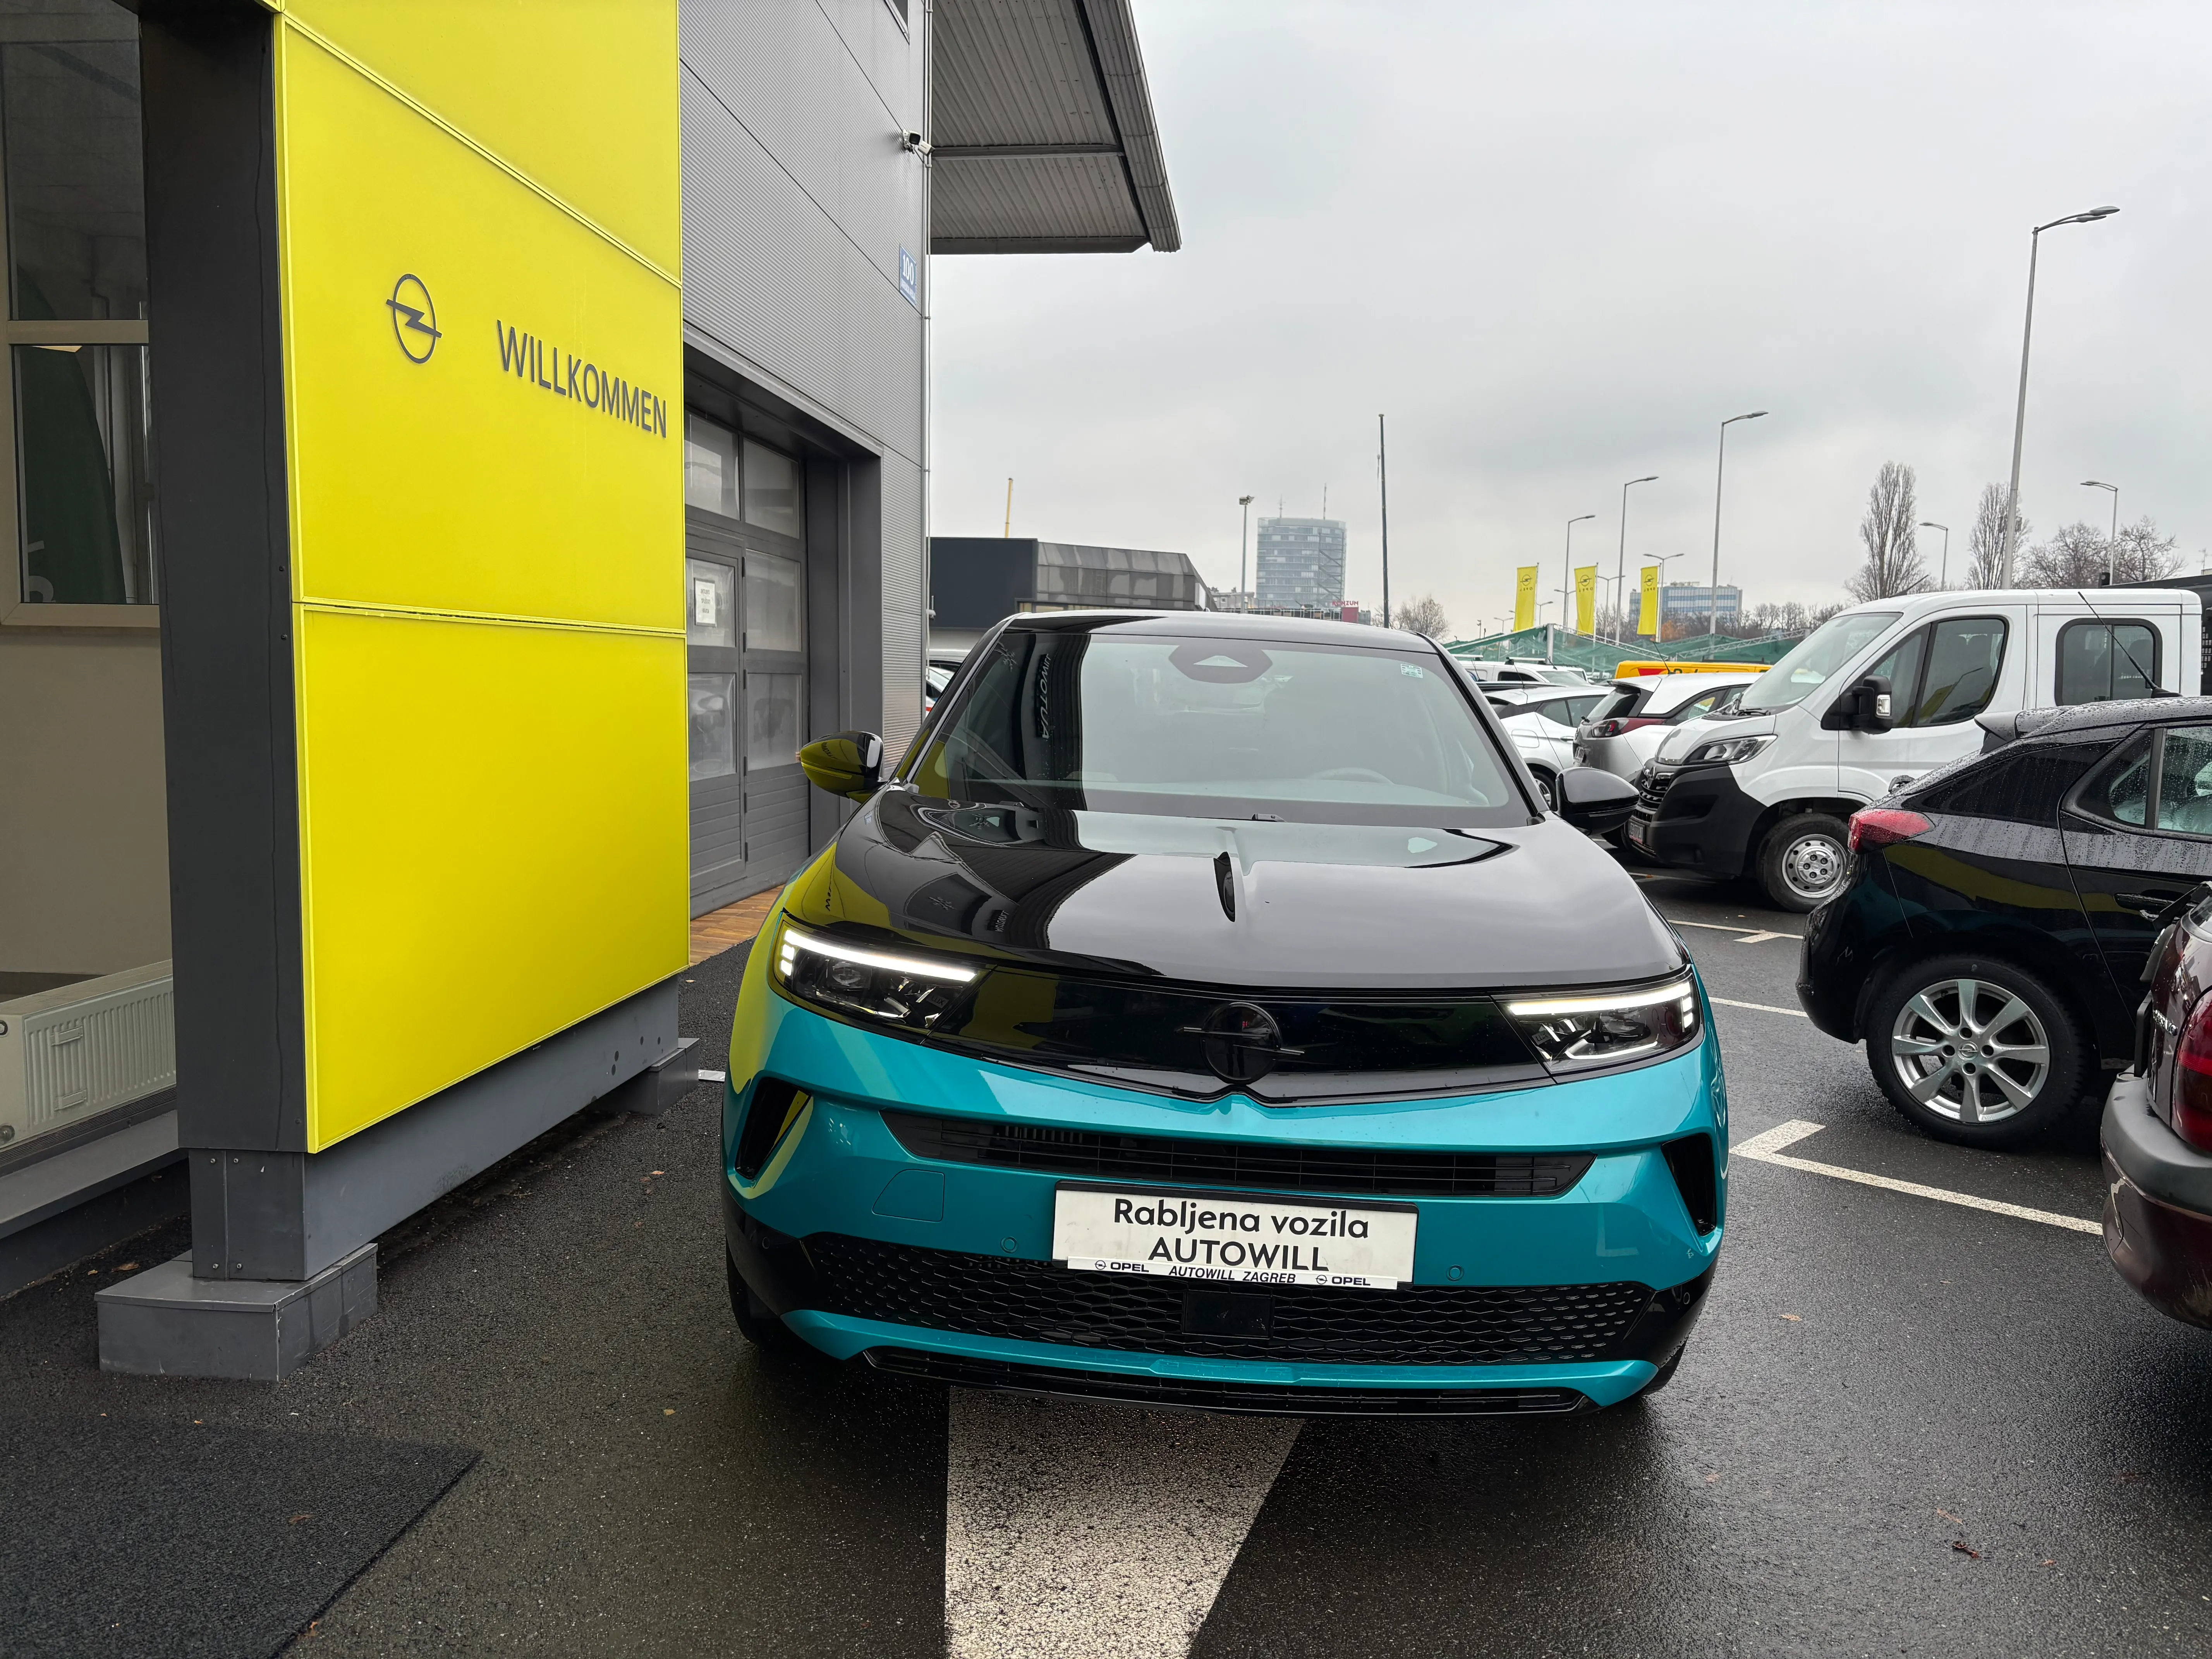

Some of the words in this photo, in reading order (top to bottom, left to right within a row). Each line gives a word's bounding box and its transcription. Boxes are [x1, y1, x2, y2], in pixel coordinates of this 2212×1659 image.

[903, 254, 914, 285] 100
[496, 319, 666, 439] WILLKOMMEN
[1114, 1198, 1260, 1235] Rabljena
[1271, 1210, 1368, 1238] vozila
[1148, 1237, 1329, 1271] AUTOWILL
[1110, 1262, 1149, 1273] OPEL
[1168, 1266, 1235, 1280] AUTOWILL
[1242, 1271, 1296, 1283] ZAGREB
[1331, 1276, 1370, 1286] OPEL
